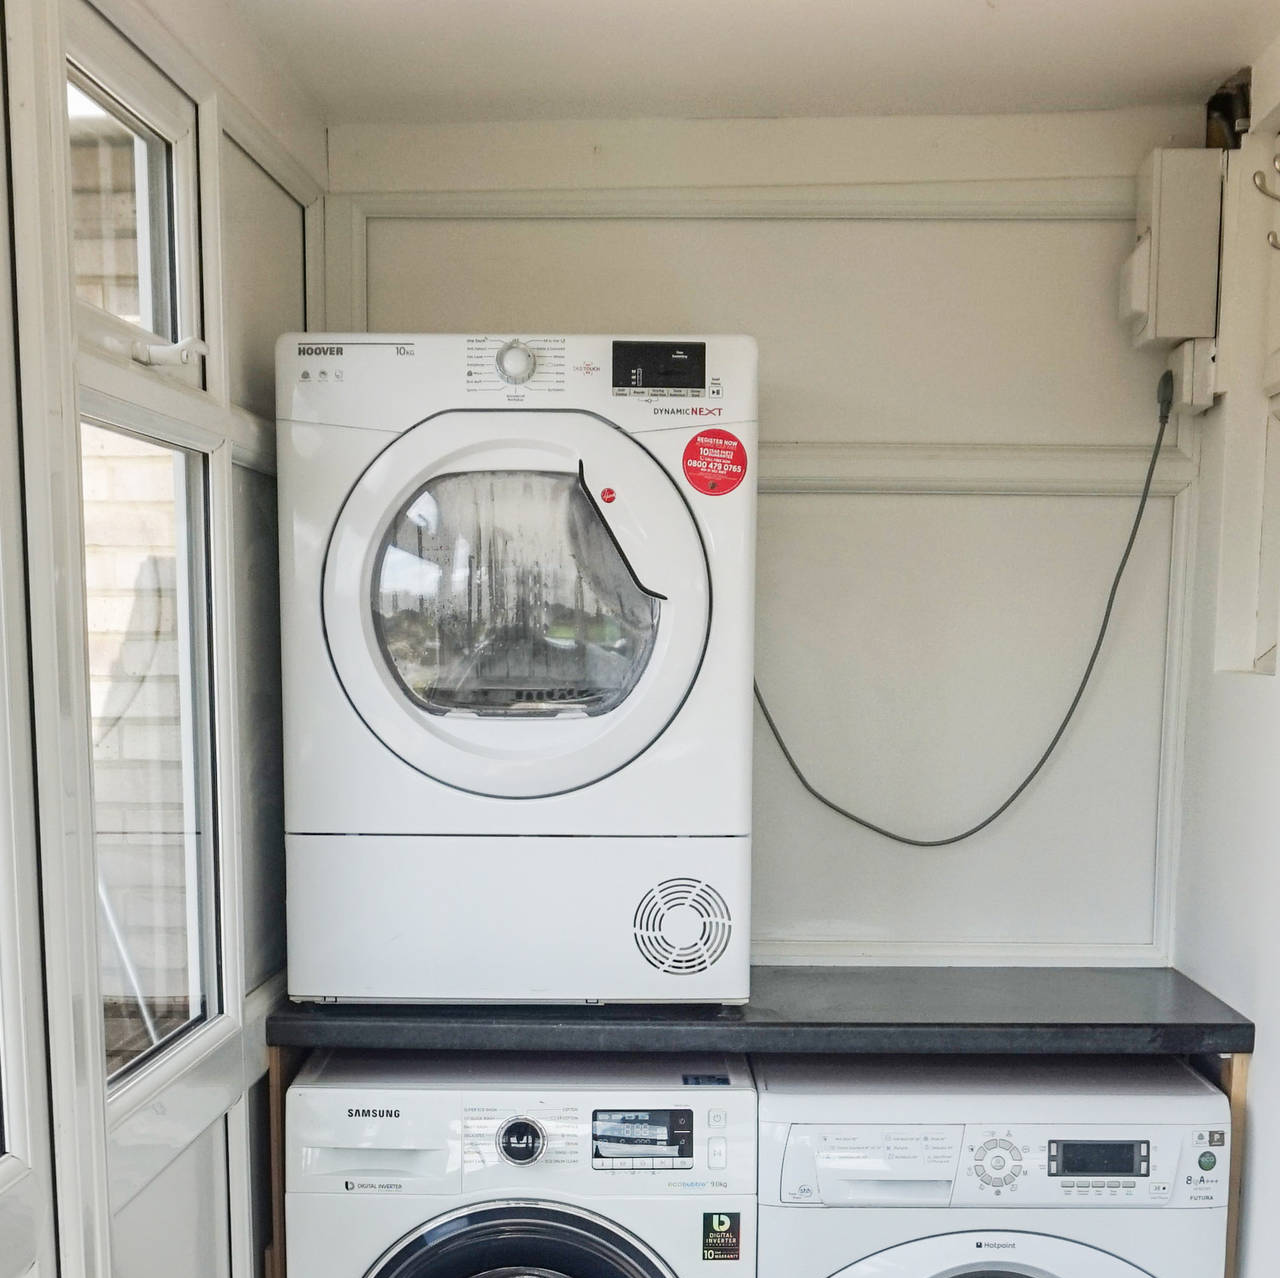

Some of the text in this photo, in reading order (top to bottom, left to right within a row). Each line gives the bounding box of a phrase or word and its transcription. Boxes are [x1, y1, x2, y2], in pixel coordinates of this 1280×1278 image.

[298, 346, 344, 356] HOOVER
[700, 447, 709, 456] 10
[687, 459, 707, 468] 0800
[708, 462, 722, 470] 479
[723, 464, 742, 472] 0765
[347, 1108, 400, 1118] SAMSUNG
[984, 1242, 1016, 1250] Hotpoint
[703, 1249, 715, 1260] 10
